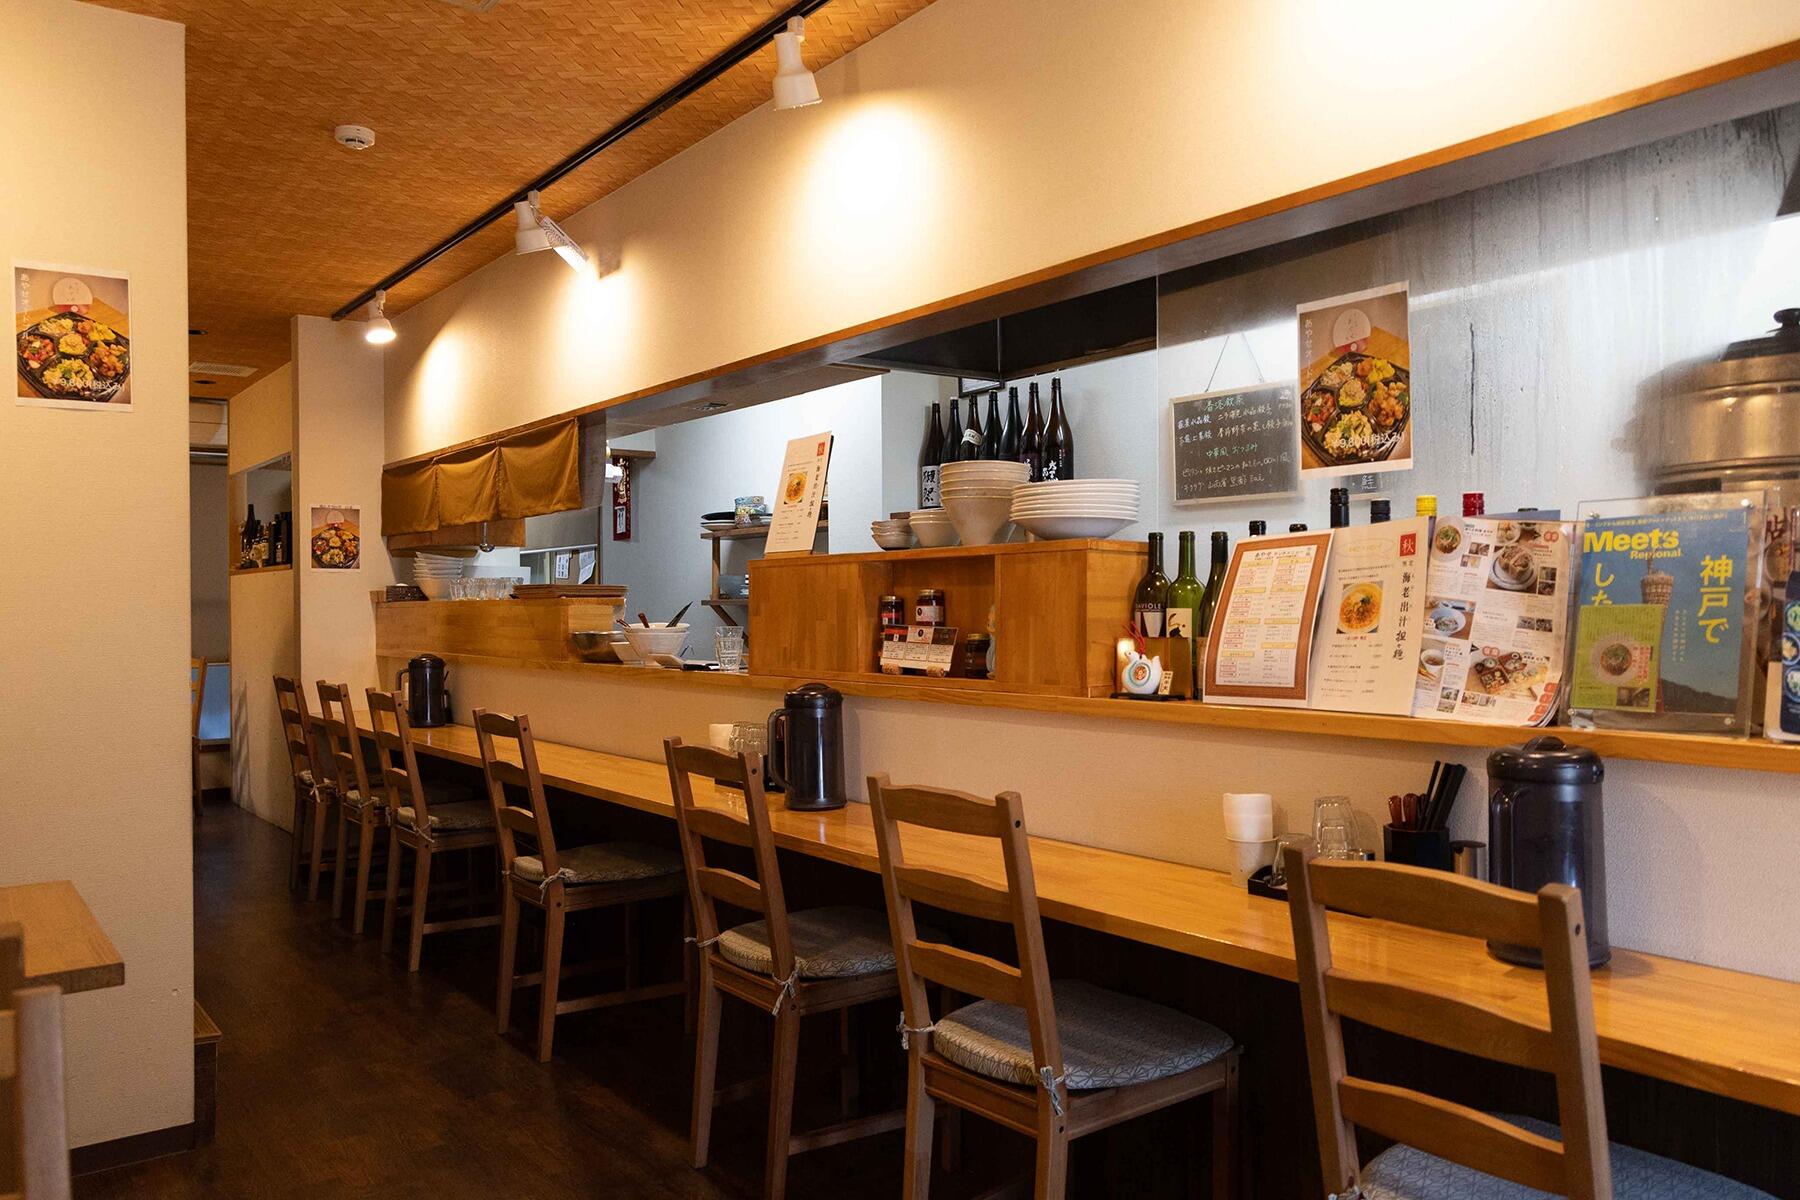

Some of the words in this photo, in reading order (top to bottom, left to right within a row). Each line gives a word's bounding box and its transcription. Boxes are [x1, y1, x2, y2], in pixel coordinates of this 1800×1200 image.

[1401, 537, 1415, 554] 秋
[1583, 528, 1679, 553] Meets
[1630, 548, 1682, 561] Regional
[1698, 554, 1733, 643] 神戸で
